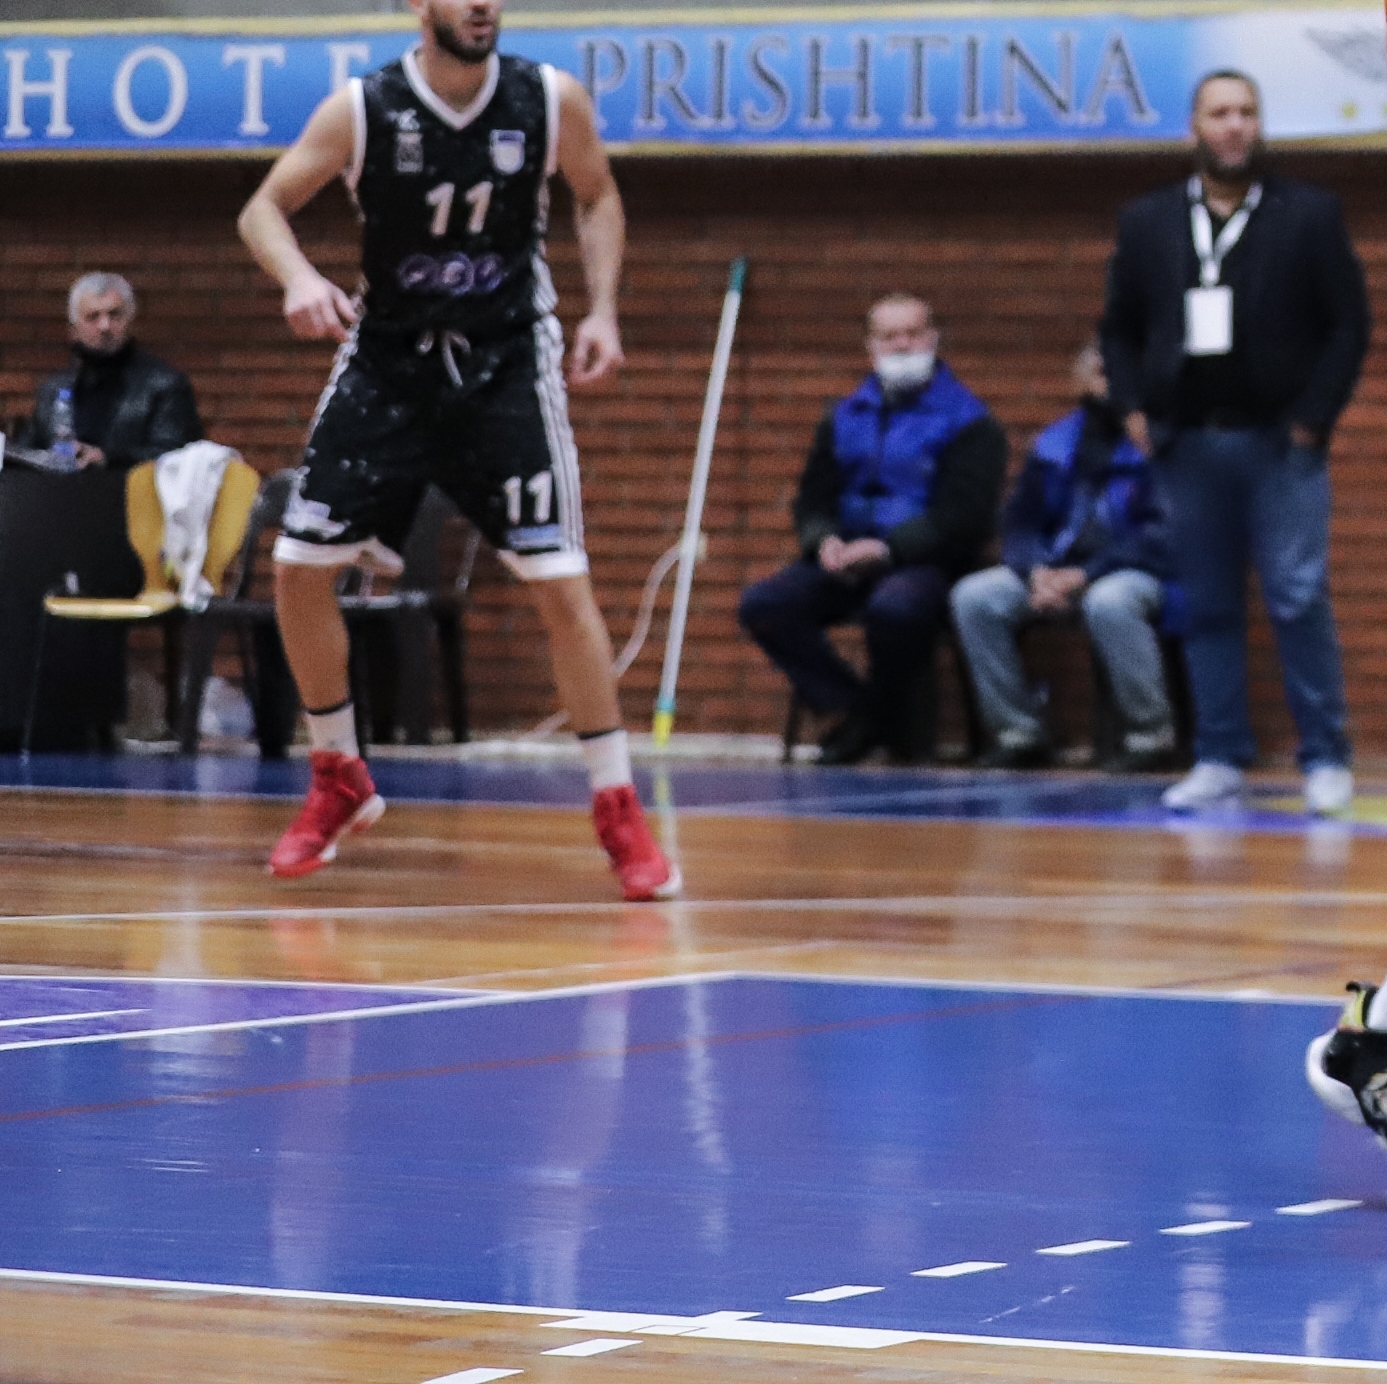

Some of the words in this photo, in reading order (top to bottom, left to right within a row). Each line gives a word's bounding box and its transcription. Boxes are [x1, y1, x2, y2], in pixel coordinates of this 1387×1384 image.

[577, 29, 1160, 129] PRISHTINA
[424, 180, 494, 238] 11
[503, 469, 554, 525] 11
